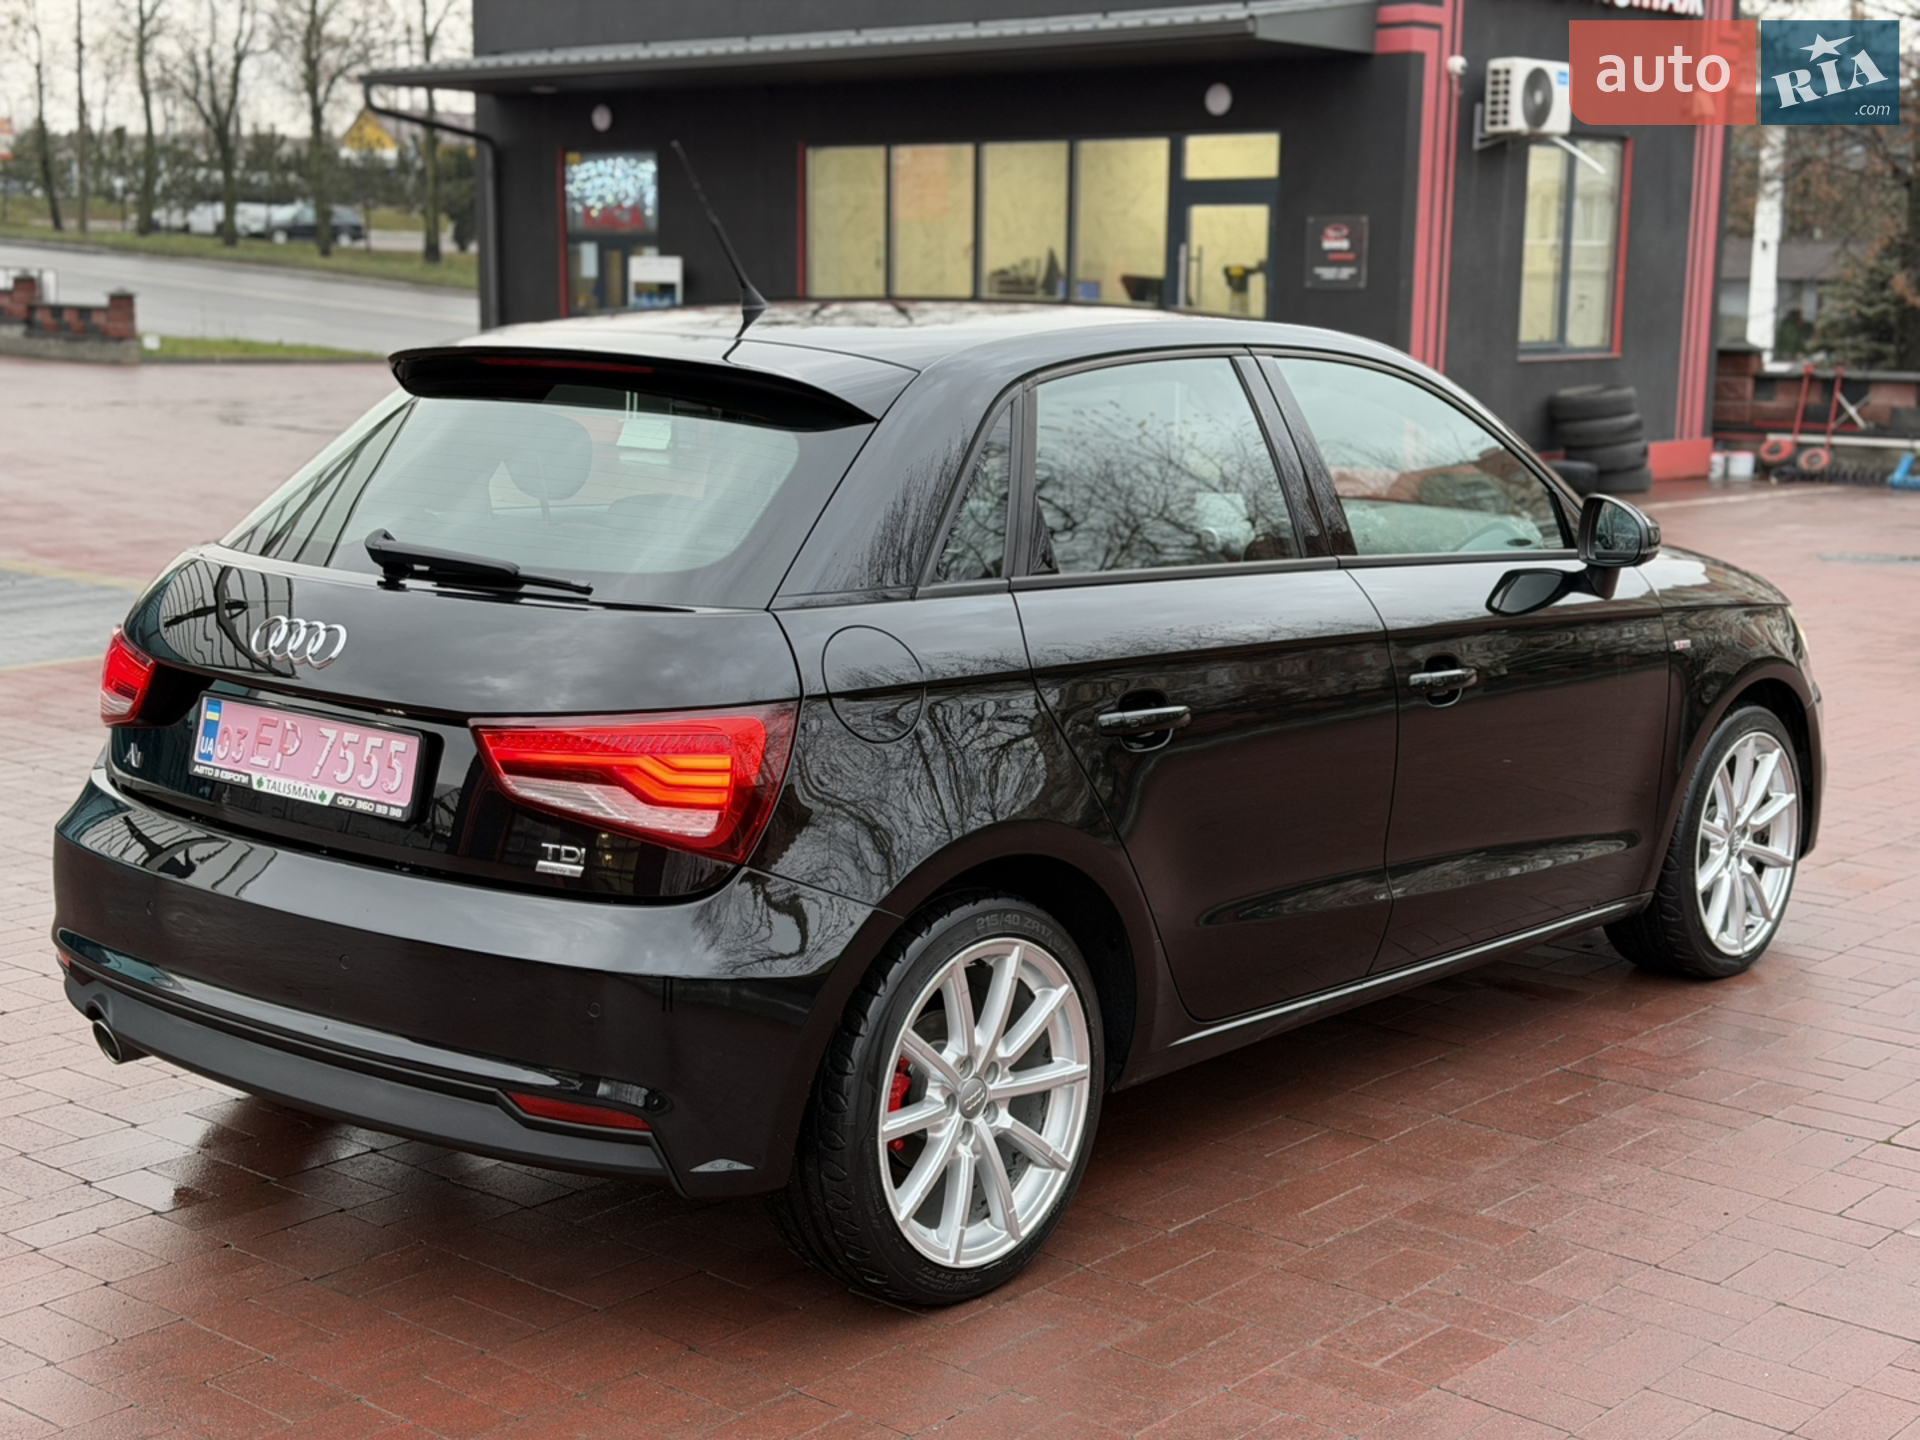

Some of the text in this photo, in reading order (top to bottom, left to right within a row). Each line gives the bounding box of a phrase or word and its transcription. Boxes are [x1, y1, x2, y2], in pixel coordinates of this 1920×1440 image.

[200, 736, 214, 755] UA
[216, 716, 407, 794] 03 EP 7555
[265, 778, 318, 801] TALISMAN
[336, 795, 355, 808] 067
[541, 842, 586, 865] TDI
[976, 913, 1021, 931] 215/40
